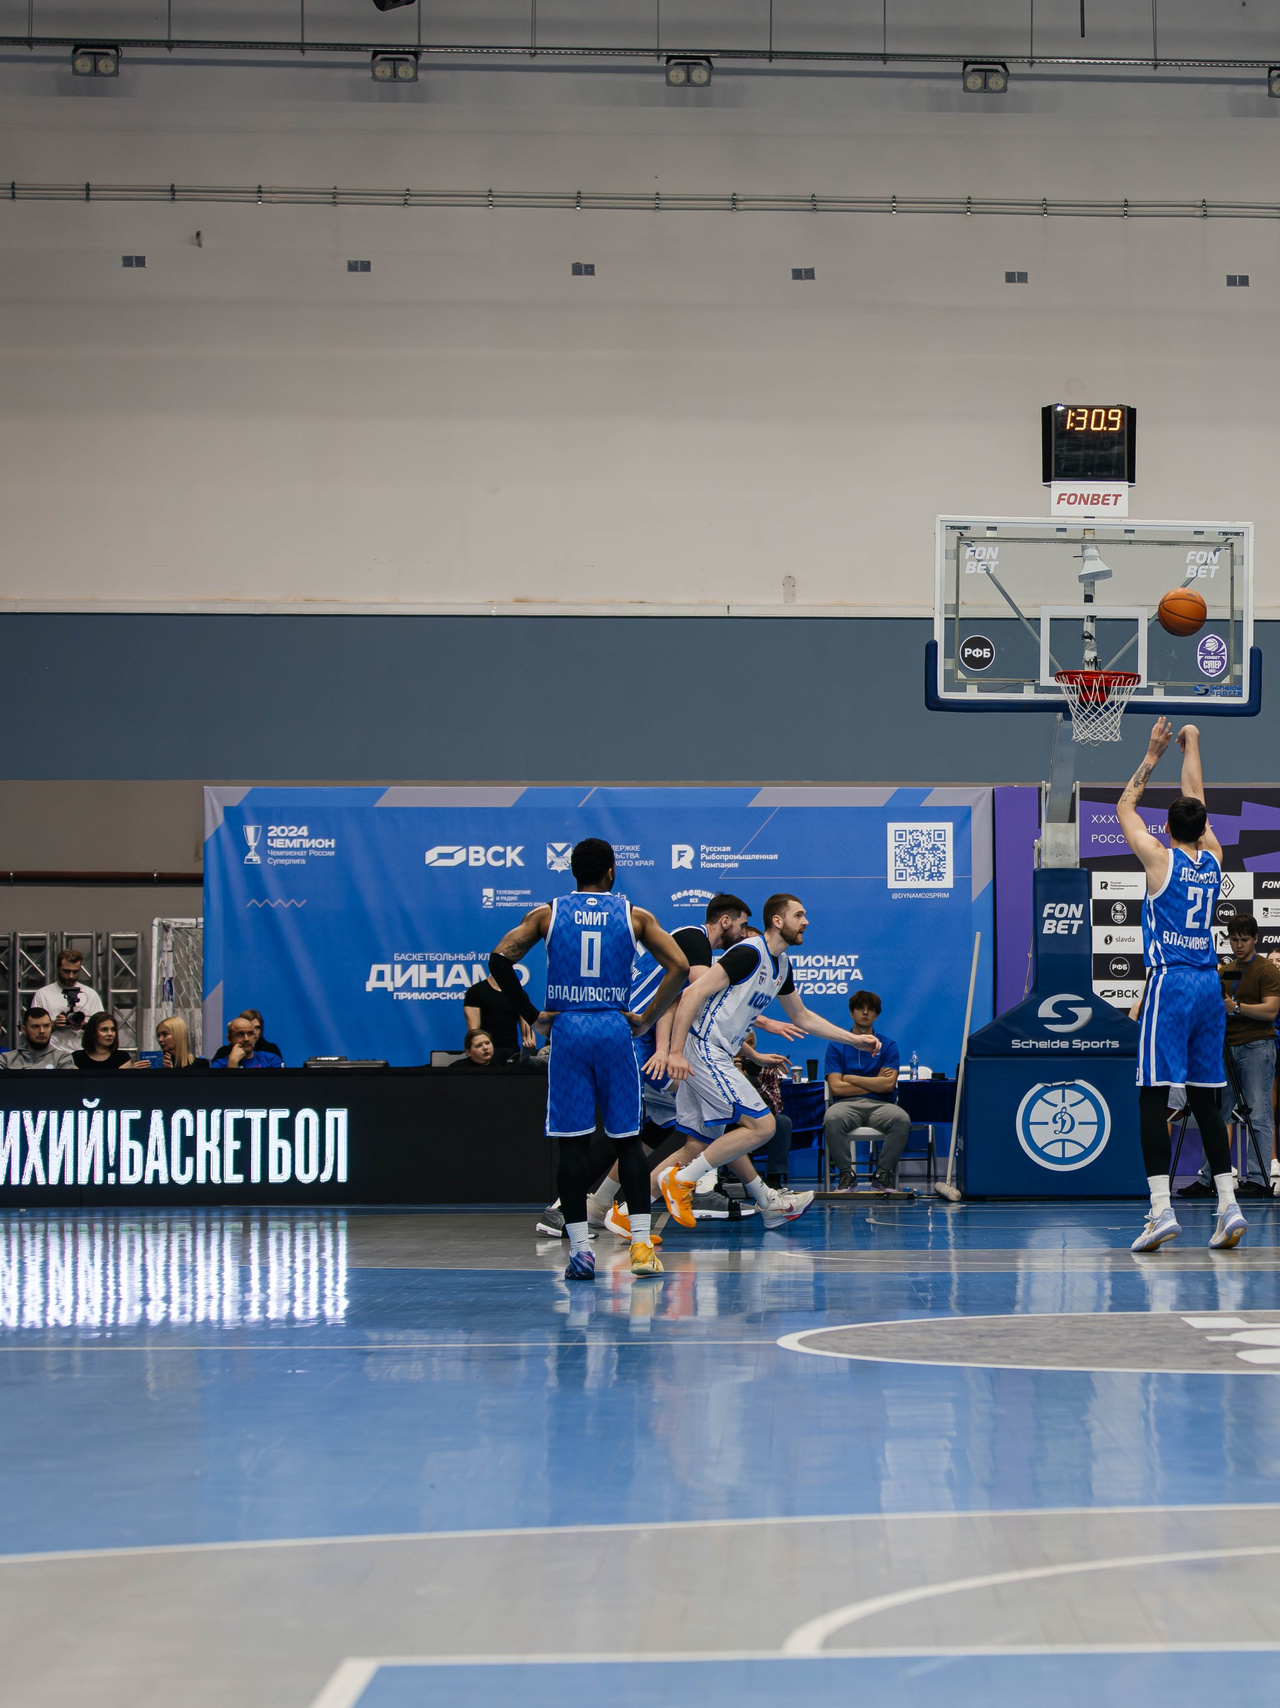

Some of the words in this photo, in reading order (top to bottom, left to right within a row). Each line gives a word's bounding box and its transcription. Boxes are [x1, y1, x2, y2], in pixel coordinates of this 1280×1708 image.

[1066, 408, 1122, 431] 1:30.9
[1056, 493, 1122, 506] FONBET
[965, 546, 998, 560] FON
[1185, 551, 1219, 564] FON
[965, 561, 998, 574] BET
[1185, 565, 1219, 578] BET
[964, 647, 991, 658] РФБ
[1203, 660, 1222, 669] СУПЕР
[267, 825, 309, 837] 2024
[266, 838, 336, 849] ЧЕМПИОН
[701, 844, 731, 853] Русская
[266, 857, 306, 866] Суперлига
[468, 846, 525, 868] ВСК
[701, 853, 778, 861] Рыбопромышленная
[891, 892, 950, 900] @DYNAMO25PRIM
[1042, 903, 1083, 918] FON
[1185, 886, 1214, 930] 21
[574, 910, 609, 926] СМИТ
[1042, 919, 1083, 935] BET
[1115, 935, 1136, 943] slavda
[393, 952, 476, 961] БАСКЕТБОЛЬНЫЙ
[478, 953, 491, 961] КЛ
[1111, 963, 1129, 971] РФБ
[1116, 989, 1139, 998] ВСК
[1011, 1039, 1069, 1049] Schelde
[1072, 1039, 1120, 1050] Sports
